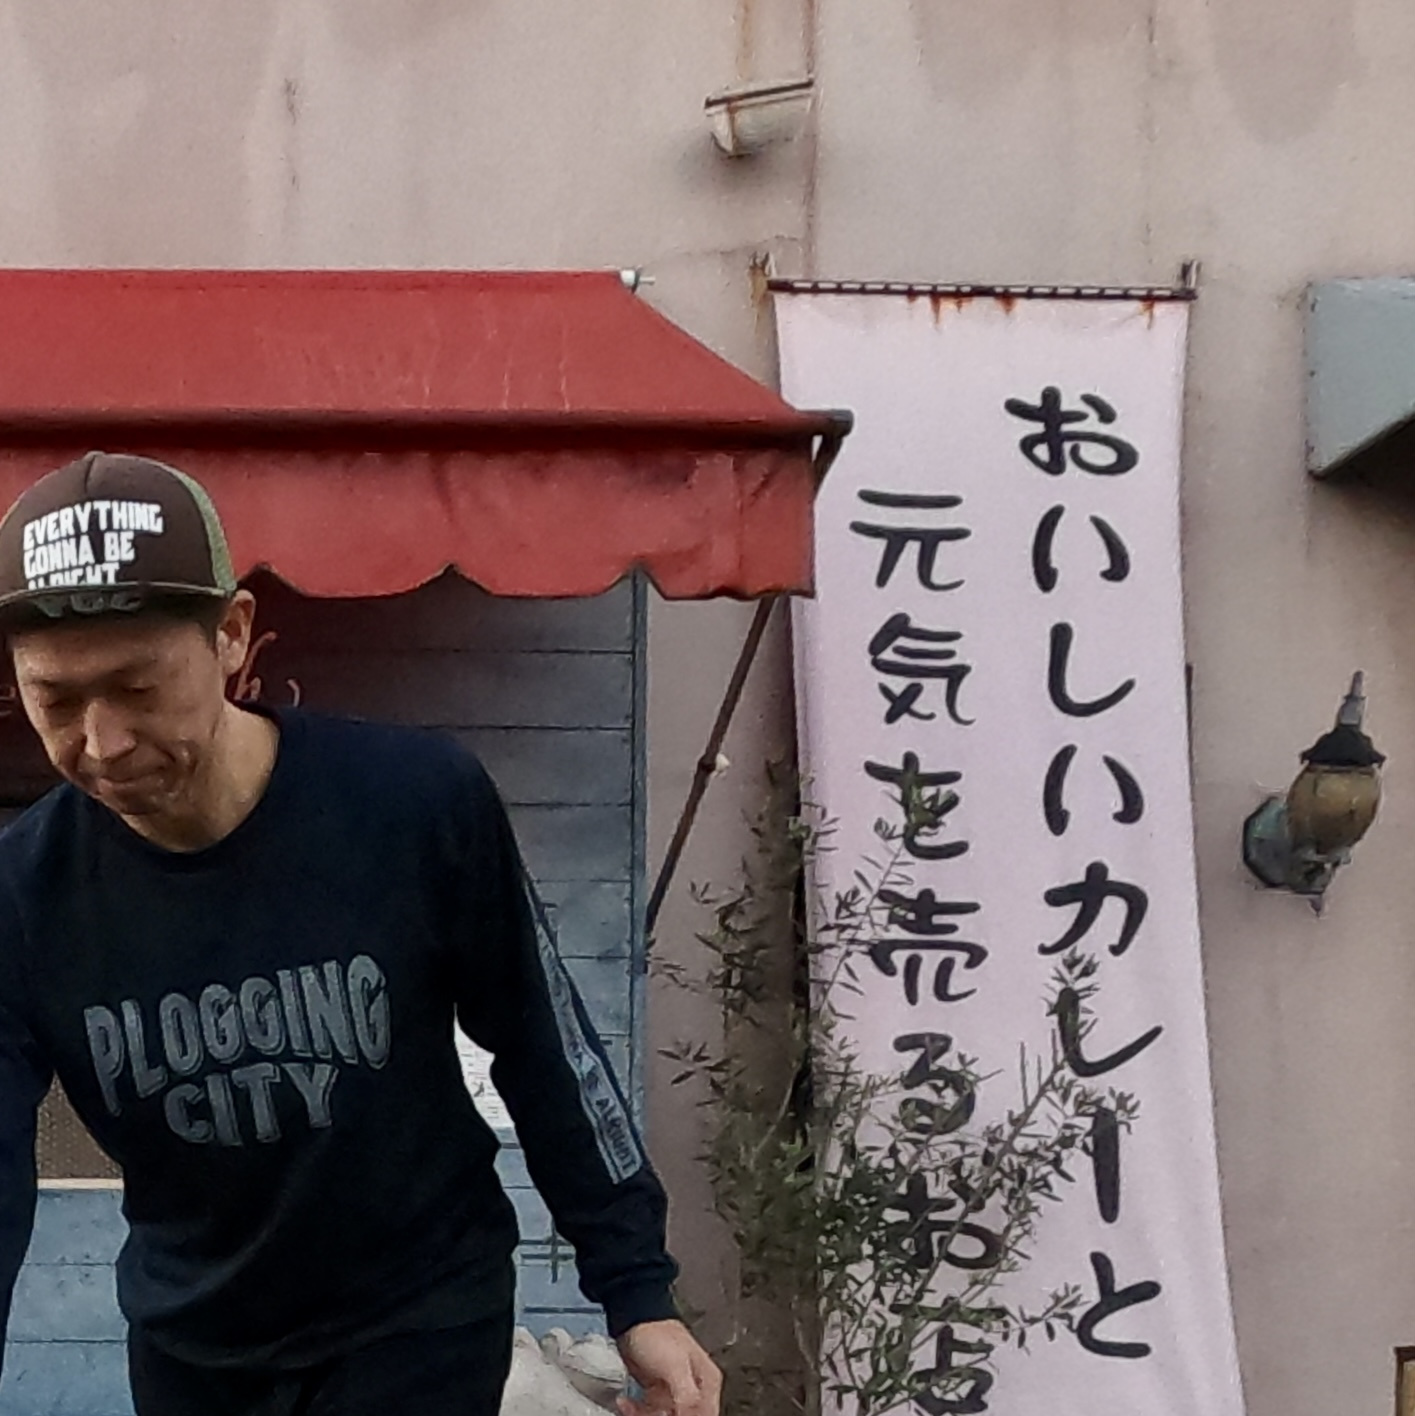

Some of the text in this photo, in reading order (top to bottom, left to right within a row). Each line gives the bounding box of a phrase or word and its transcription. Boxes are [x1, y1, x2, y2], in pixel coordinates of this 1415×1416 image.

[22, 499, 164, 550] EVERYTHING
[23, 530, 136, 580] GONNA BE
[1003, 385, 1164, 1359] おいしいカレーと
[84, 953, 392, 1118] PLOGGING
[163, 1061, 340, 1147] CITY
